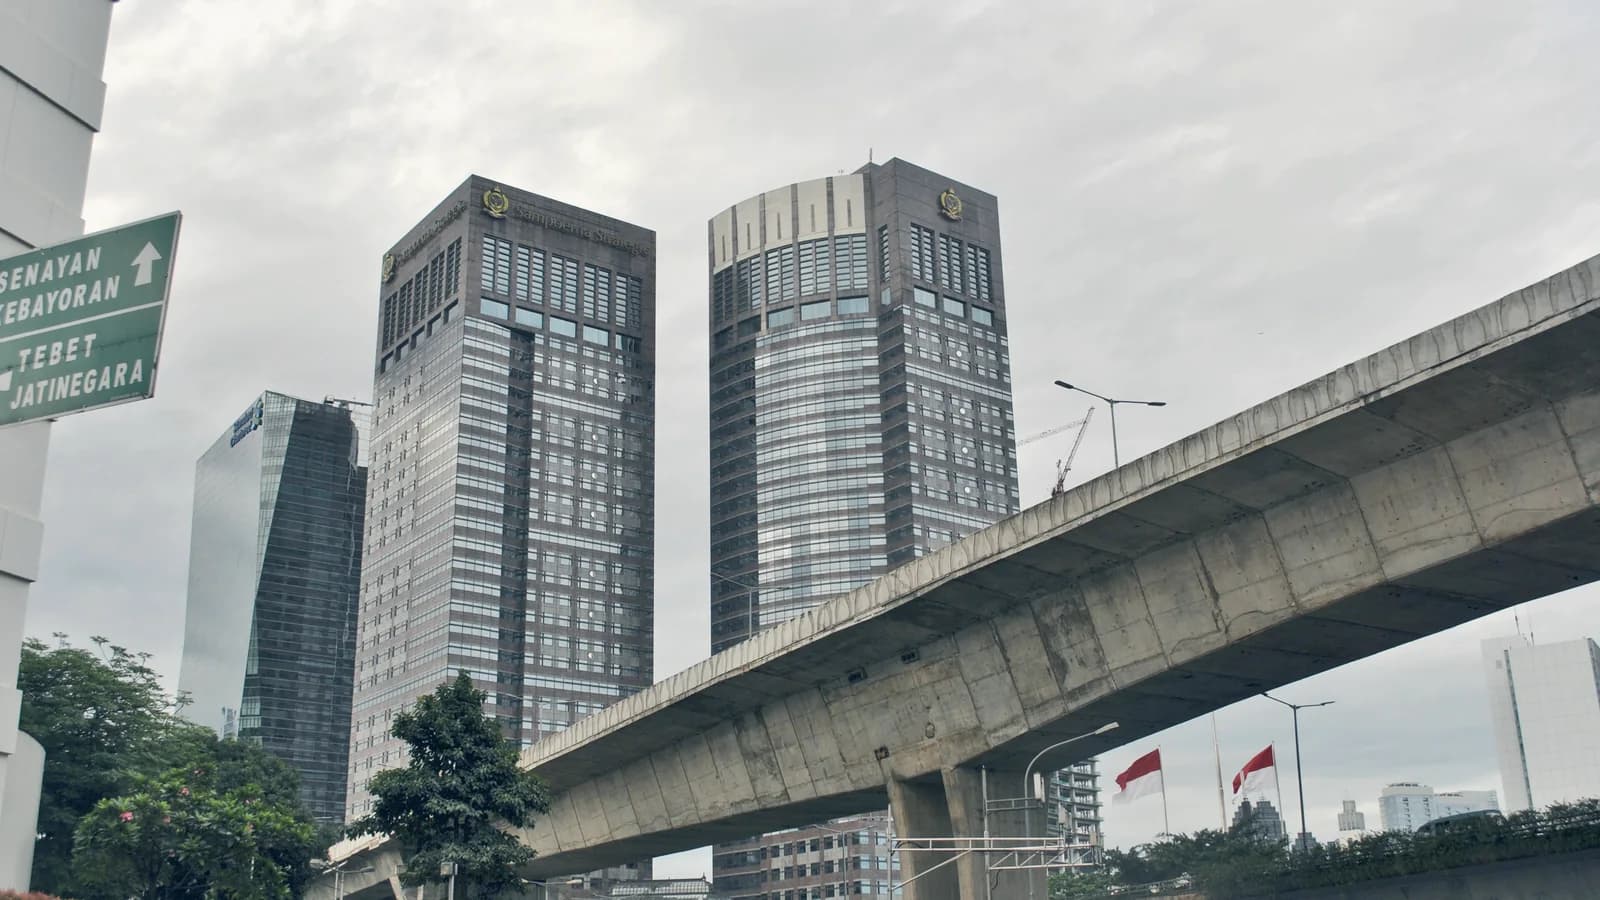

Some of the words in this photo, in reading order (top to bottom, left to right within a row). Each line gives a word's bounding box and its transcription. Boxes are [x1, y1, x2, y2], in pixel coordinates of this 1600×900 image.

[515, 204, 593, 238] Sampoerna
[0, 247, 102, 294] SENAYAN
[18, 333, 97, 373] TEBET
[10, 359, 144, 410] JATINEGARA
